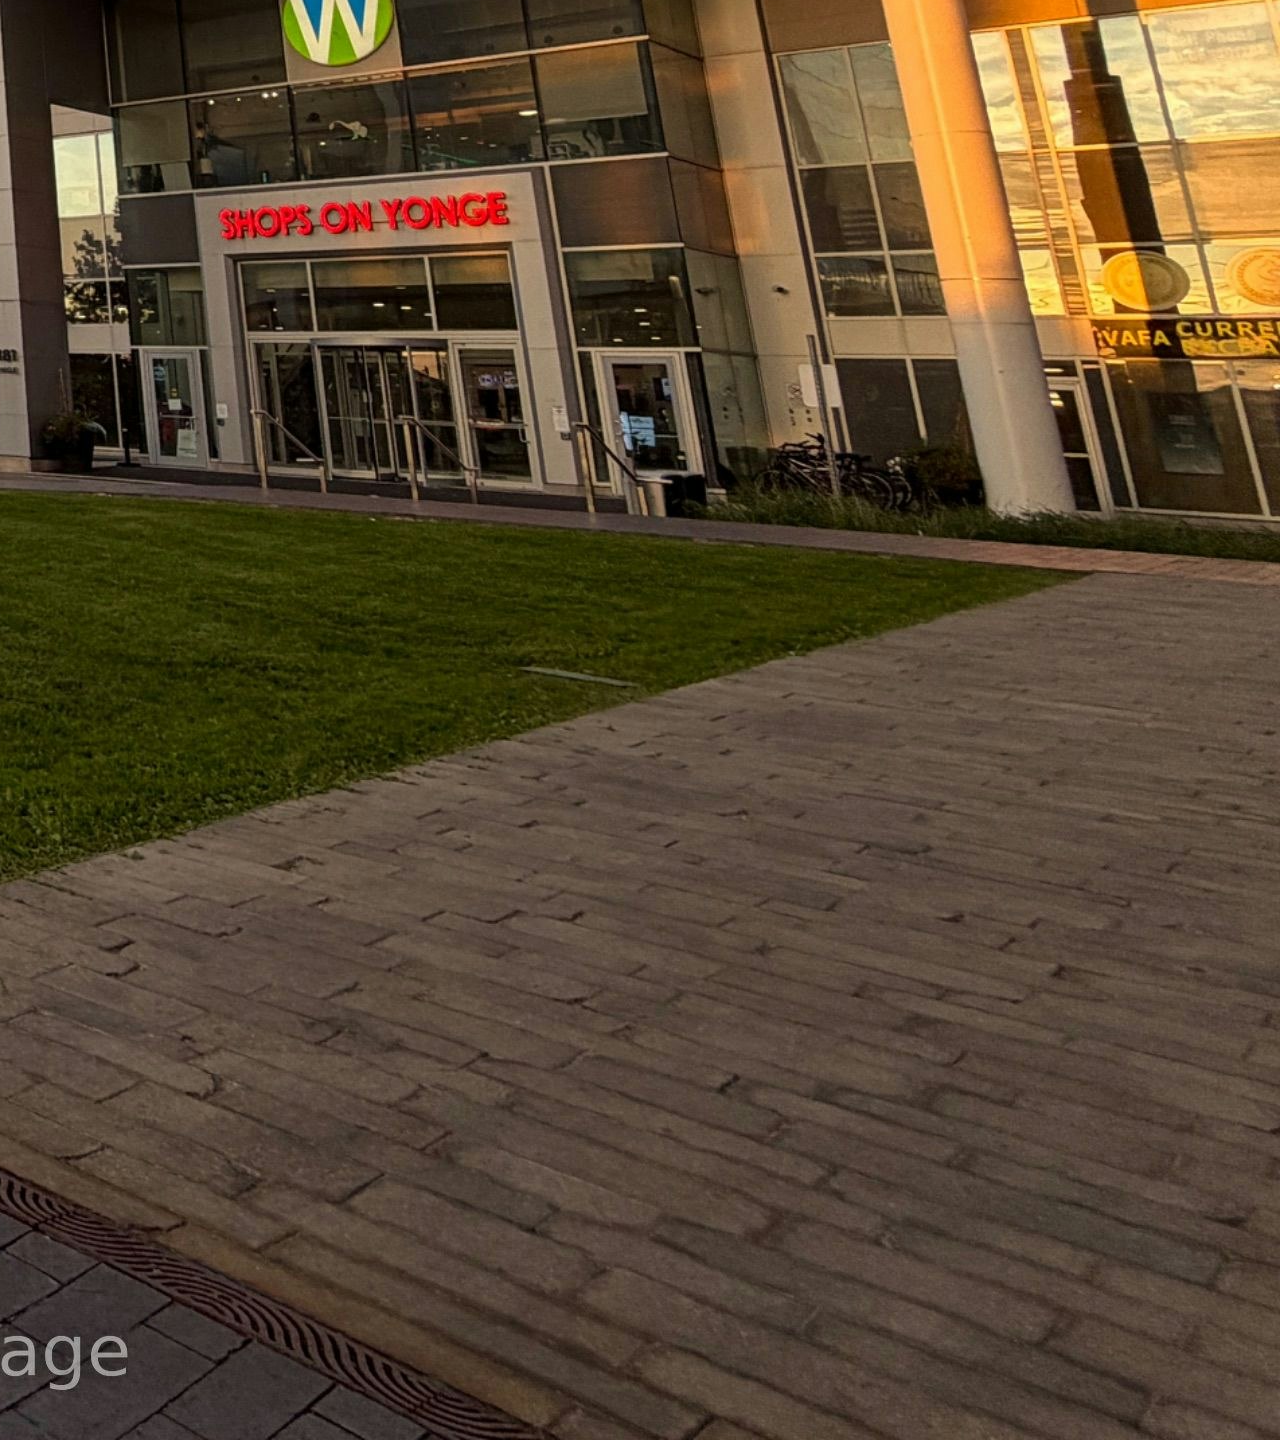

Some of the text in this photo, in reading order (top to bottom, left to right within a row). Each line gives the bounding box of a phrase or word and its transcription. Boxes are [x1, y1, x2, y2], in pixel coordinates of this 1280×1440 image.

[219, 191, 509, 240] SHOPS ON YONGE
[1175, 320, 1280, 339] CURRE
